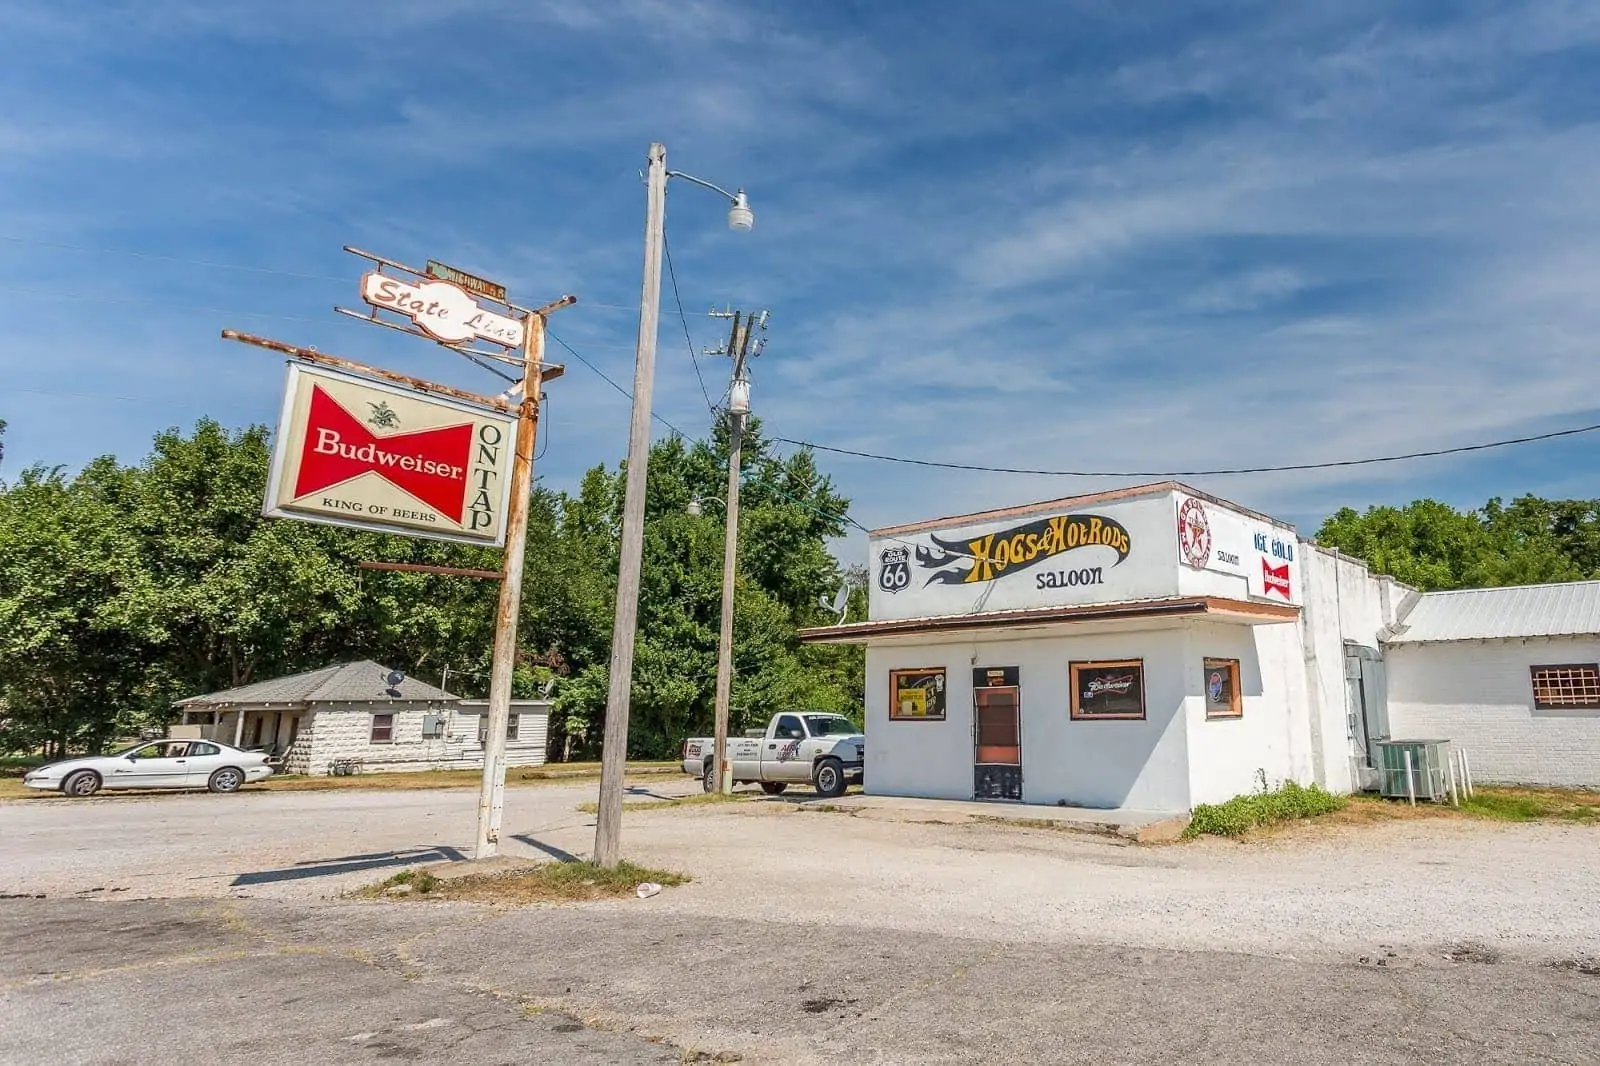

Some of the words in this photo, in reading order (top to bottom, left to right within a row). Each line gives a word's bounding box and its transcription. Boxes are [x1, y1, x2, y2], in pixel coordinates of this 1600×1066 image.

[374, 280, 449, 318] State
[462, 313, 517, 339] Line
[313, 427, 463, 480] Budweiser
[476, 424, 502, 466] ON
[322, 498, 363, 512] KING
[368, 504, 388, 515] OF
[392, 508, 437, 522] BEERS
[467, 469, 497, 530] TAP
[885, 555, 906, 563] ROUTE
[1253, 532, 1268, 553] ICE
[883, 563, 907, 587] 66
